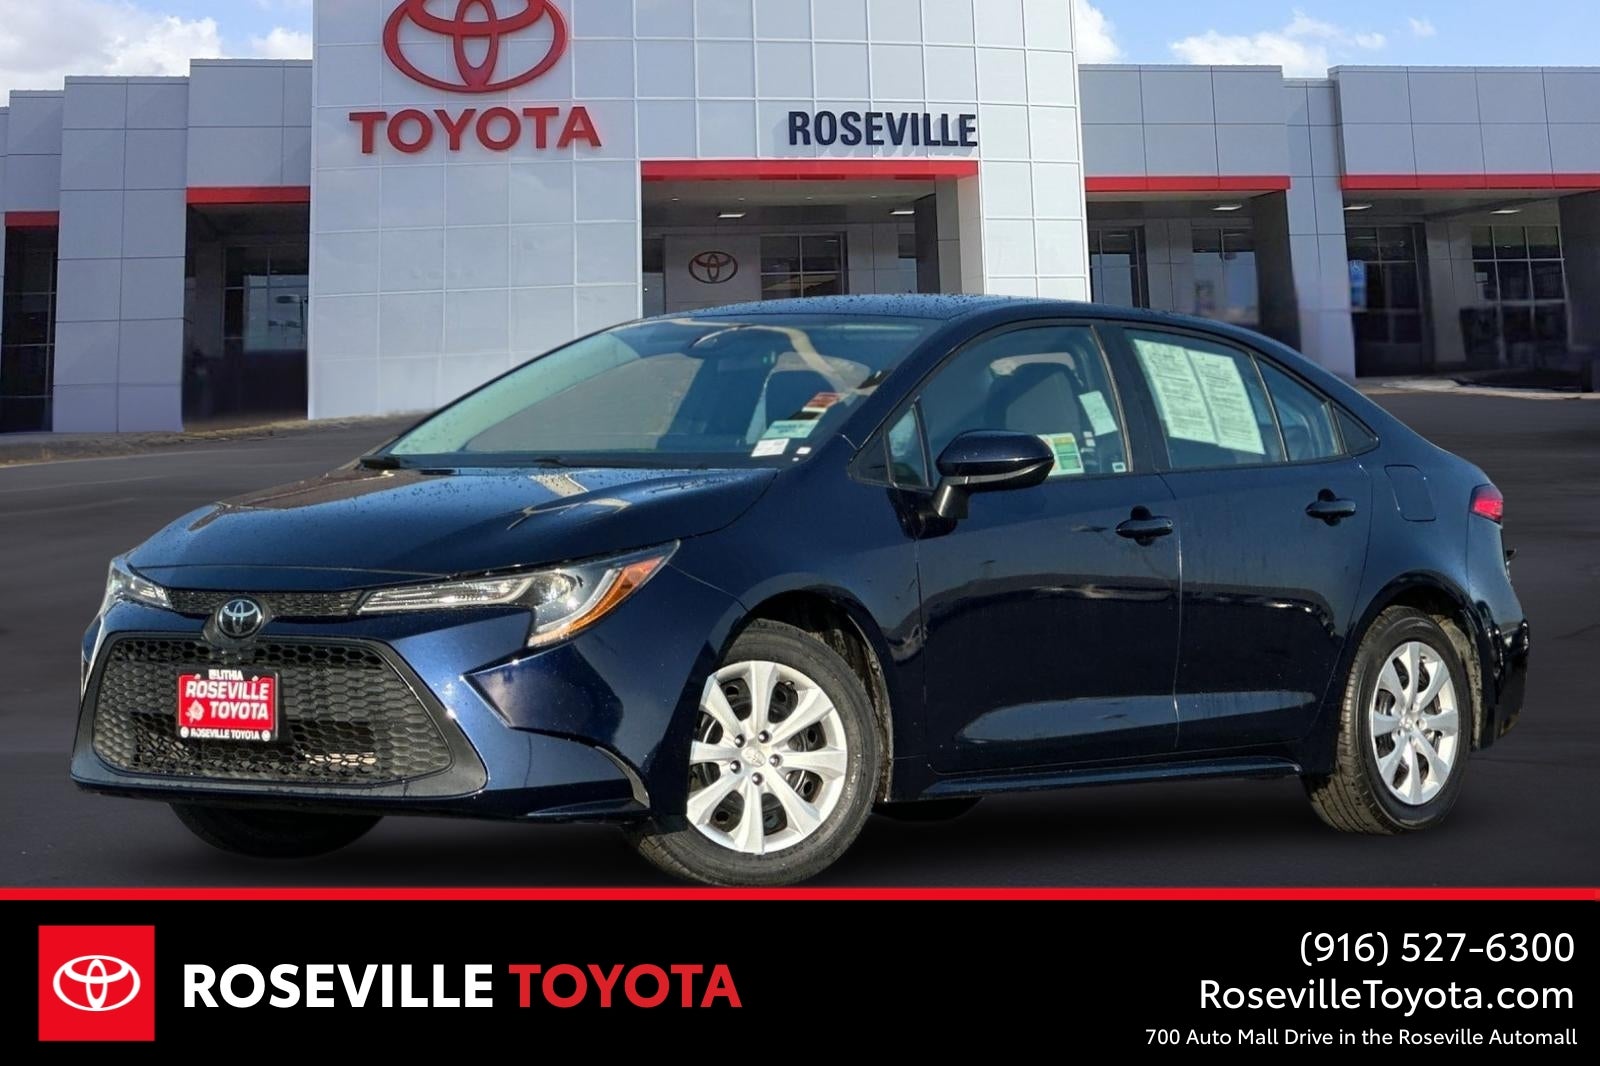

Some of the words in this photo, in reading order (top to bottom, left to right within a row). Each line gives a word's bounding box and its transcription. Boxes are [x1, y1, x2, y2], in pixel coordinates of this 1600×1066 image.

[349, 106, 602, 154] TOYOTA
[788, 111, 978, 147] ROSEVILLE
[185, 680, 270, 701] ROSEVILLE
[209, 701, 269, 720] TOYOTA
[190, 728, 230, 739] ROSEVILLE
[230, 730, 261, 740] TOYOTA
